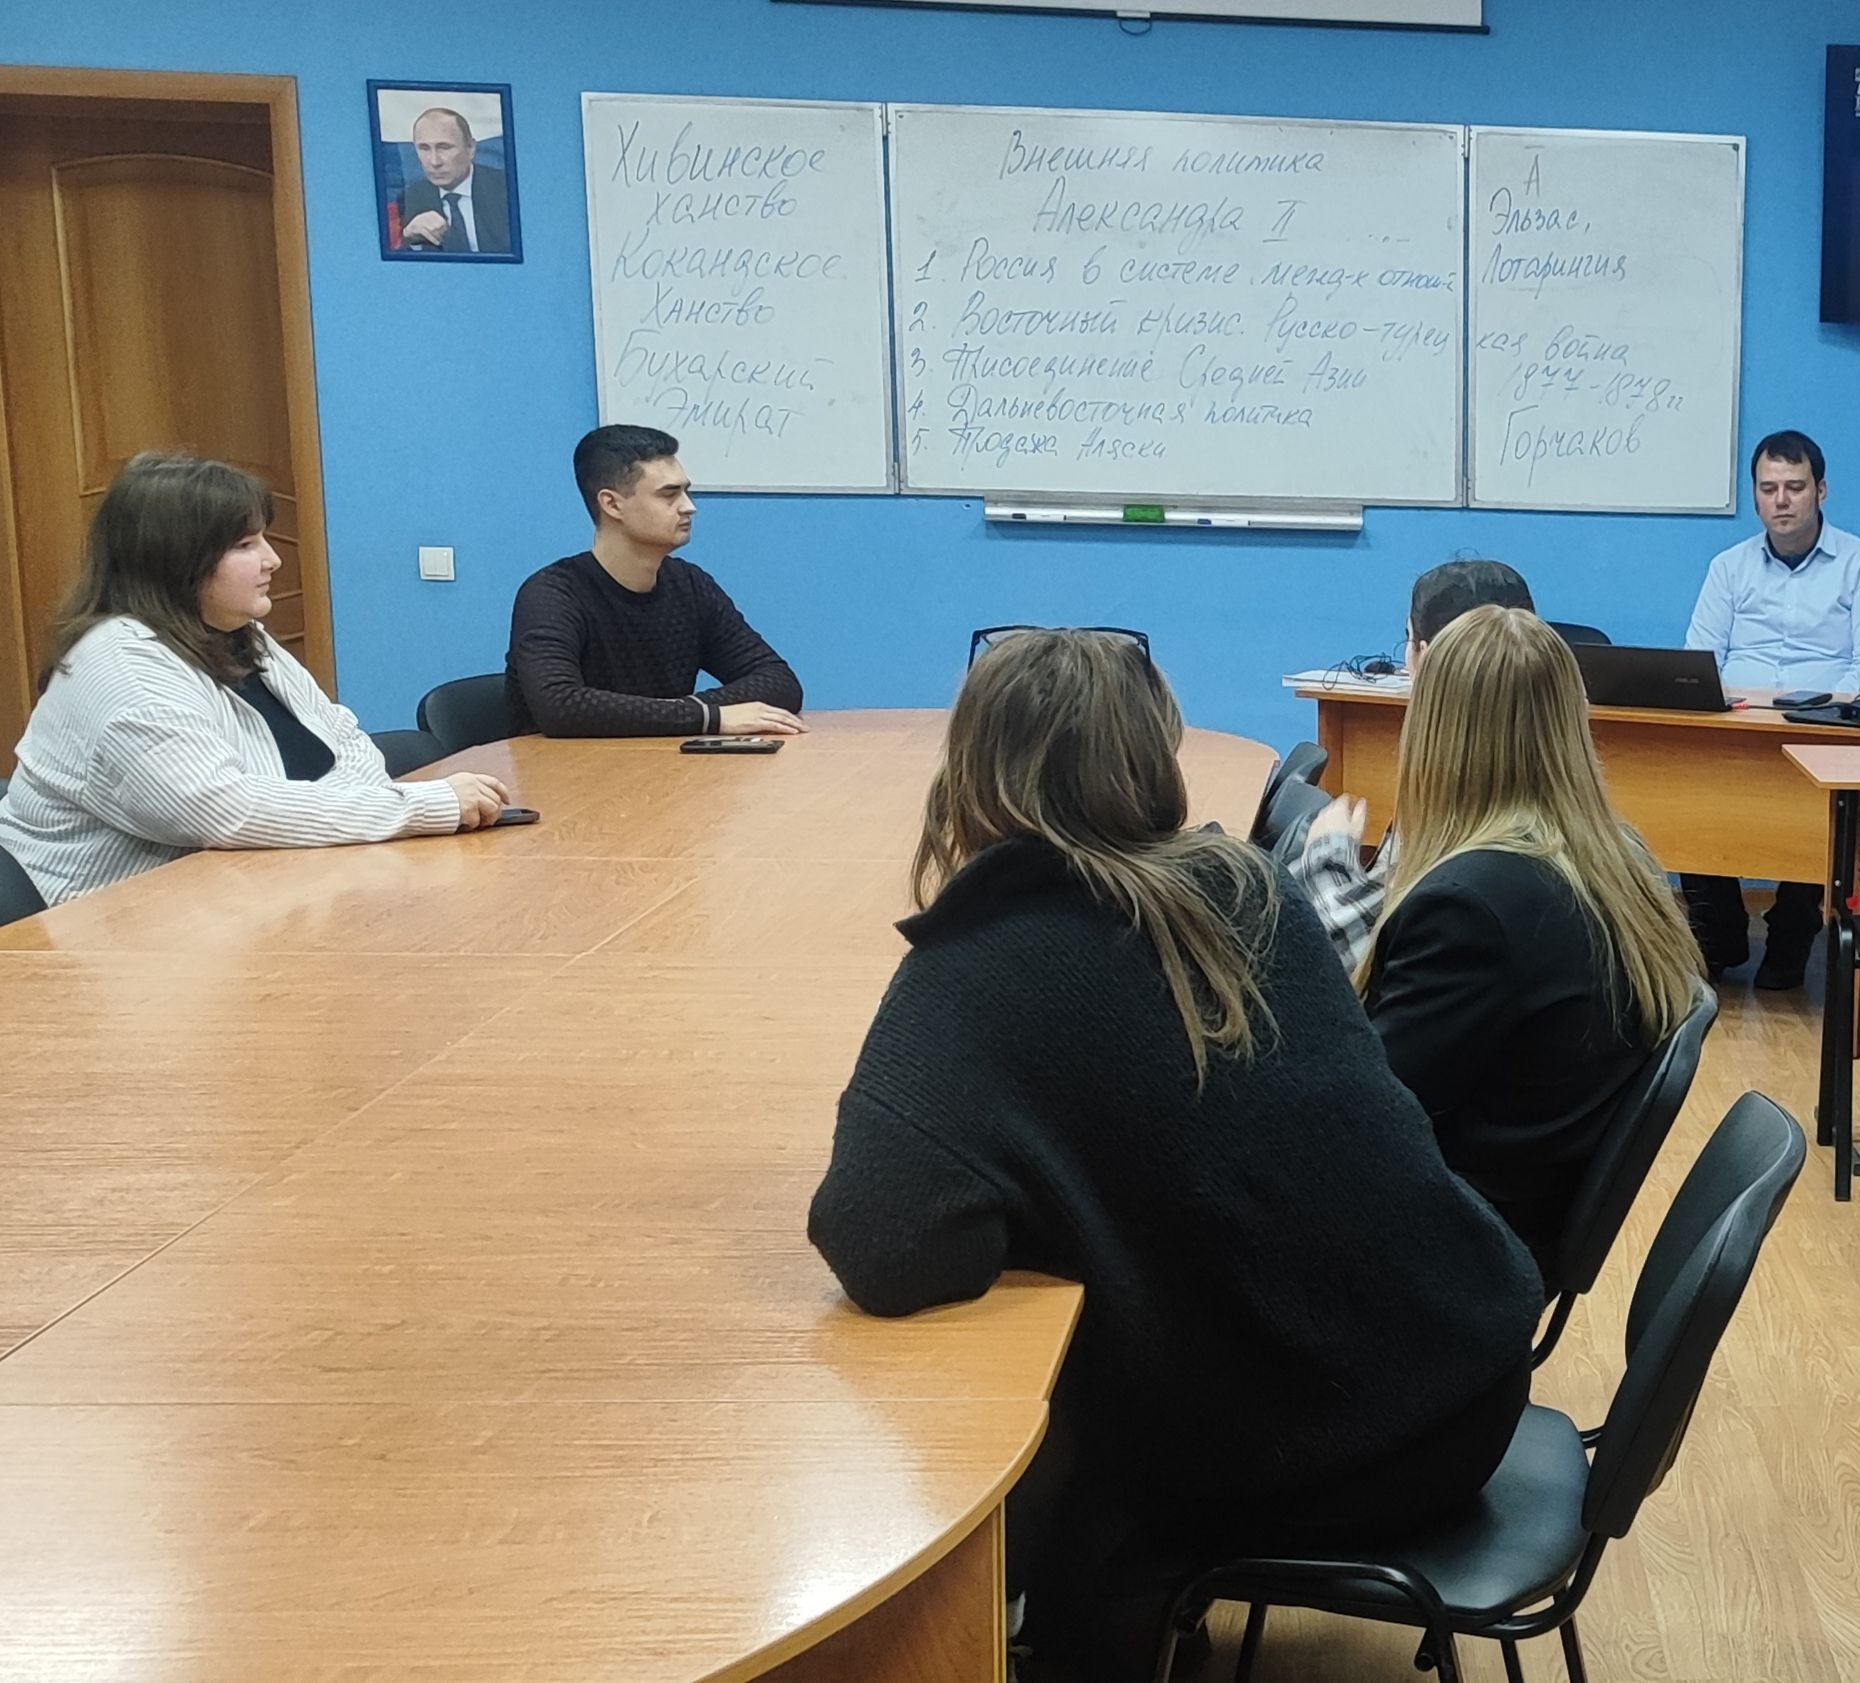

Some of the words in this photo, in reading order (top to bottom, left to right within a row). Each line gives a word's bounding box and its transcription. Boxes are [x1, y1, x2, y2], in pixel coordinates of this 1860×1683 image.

[612, 121, 826, 188] Хивинское
[999, 129, 1152, 179] Внешняя
[1172, 149, 1325, 175] политика
[646, 179, 797, 225] ханство
[1033, 175, 1245, 255] Александра
[610, 228, 842, 295] Кокандское
[960, 236, 1057, 284] Россия
[1482, 243, 1627, 300] Лотарингия
[951, 290, 1127, 338] Восточный
[614, 329, 834, 403] Бухарский
[942, 342, 1154, 395] Присоединение
[1179, 344, 1294, 405] Средней
[1303, 351, 1367, 394] Азии
[1545, 325, 1630, 367] война
[653, 387, 803, 457] Эмират
[947, 384, 1185, 427] Дальневосточная
[1204, 401, 1313, 428] политика
[948, 426, 1057, 471] Продажа
[1076, 427, 1166, 461] Аляски
[1500, 404, 1645, 488] Горчаков
